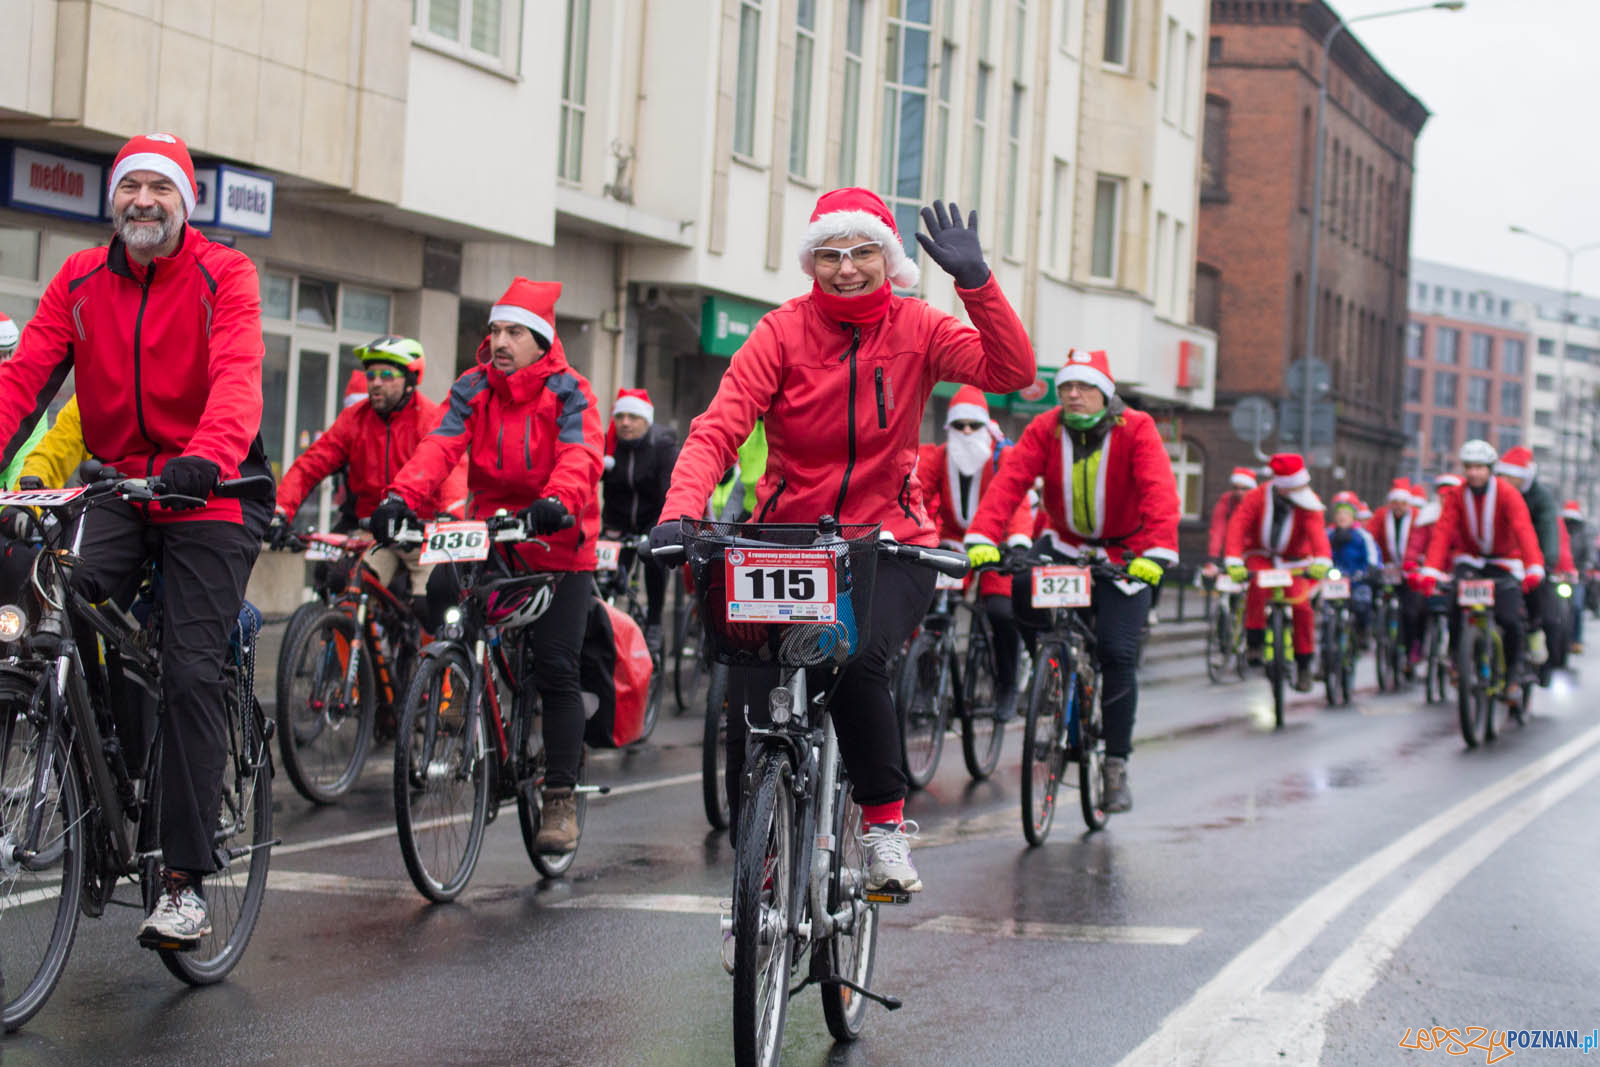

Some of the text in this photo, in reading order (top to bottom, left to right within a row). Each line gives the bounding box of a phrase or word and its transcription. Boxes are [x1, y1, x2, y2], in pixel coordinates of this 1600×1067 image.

[30, 162, 84, 197] medkon
[228, 184, 265, 215] apteka
[745, 569, 815, 600] 115
[1042, 577, 1081, 594] 321
